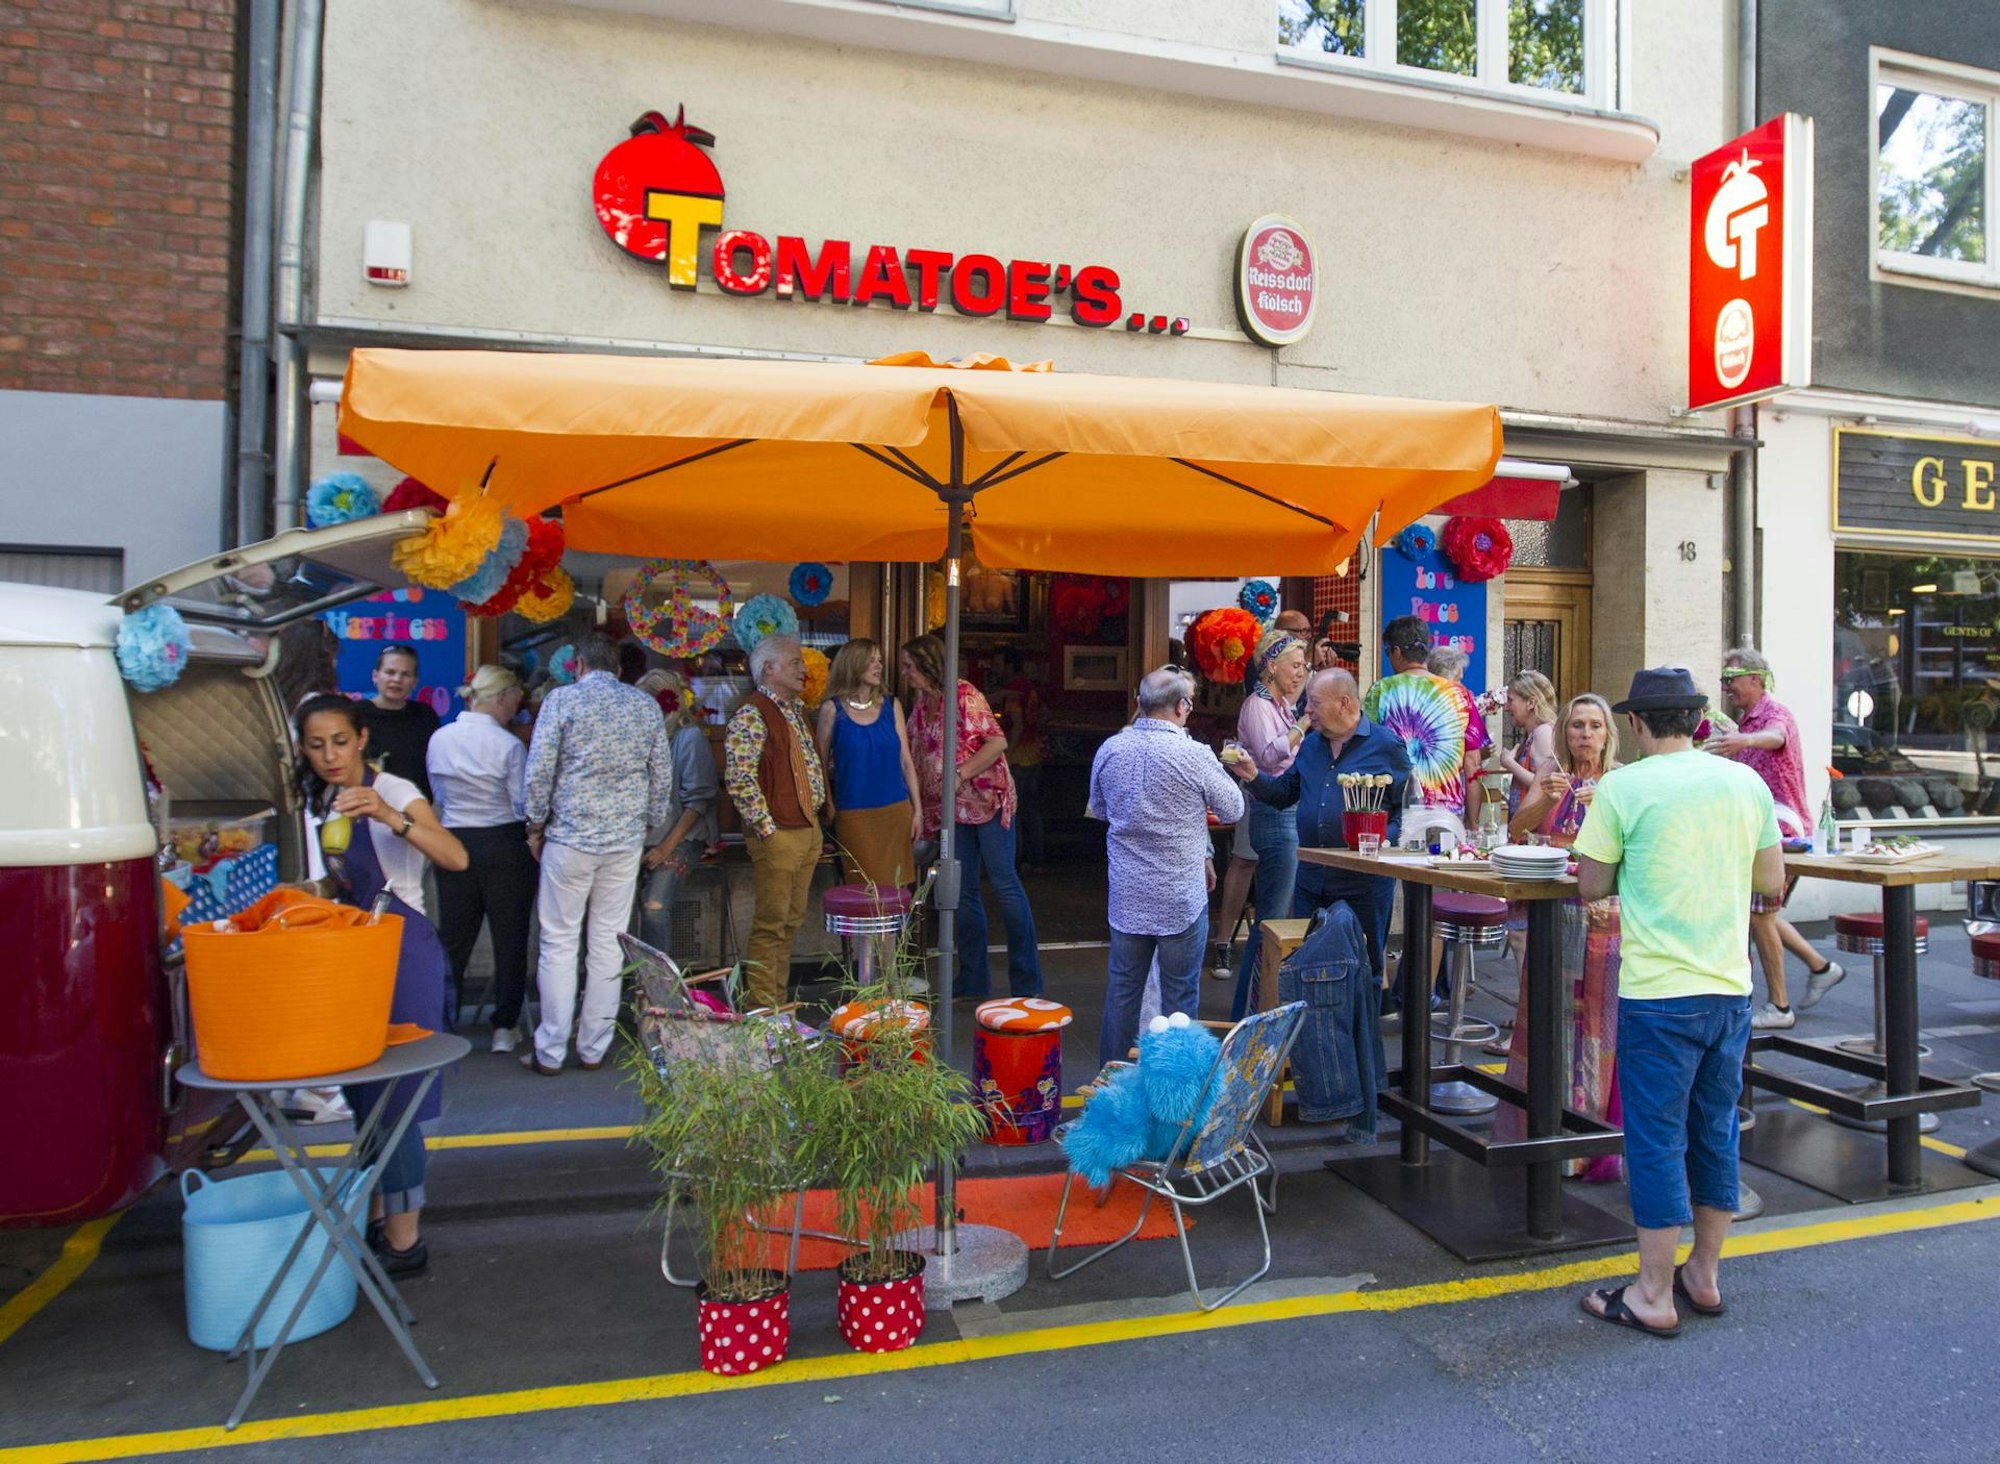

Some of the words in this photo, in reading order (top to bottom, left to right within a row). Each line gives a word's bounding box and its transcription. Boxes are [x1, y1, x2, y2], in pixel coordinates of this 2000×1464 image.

[1249, 266, 1313, 292] Reissdorf
[1258, 290, 1302, 316] Kölsch
[1678, 540, 1697, 562] 18
[1415, 566, 1455, 590] Love
[1411, 596, 1459, 623] Peace
